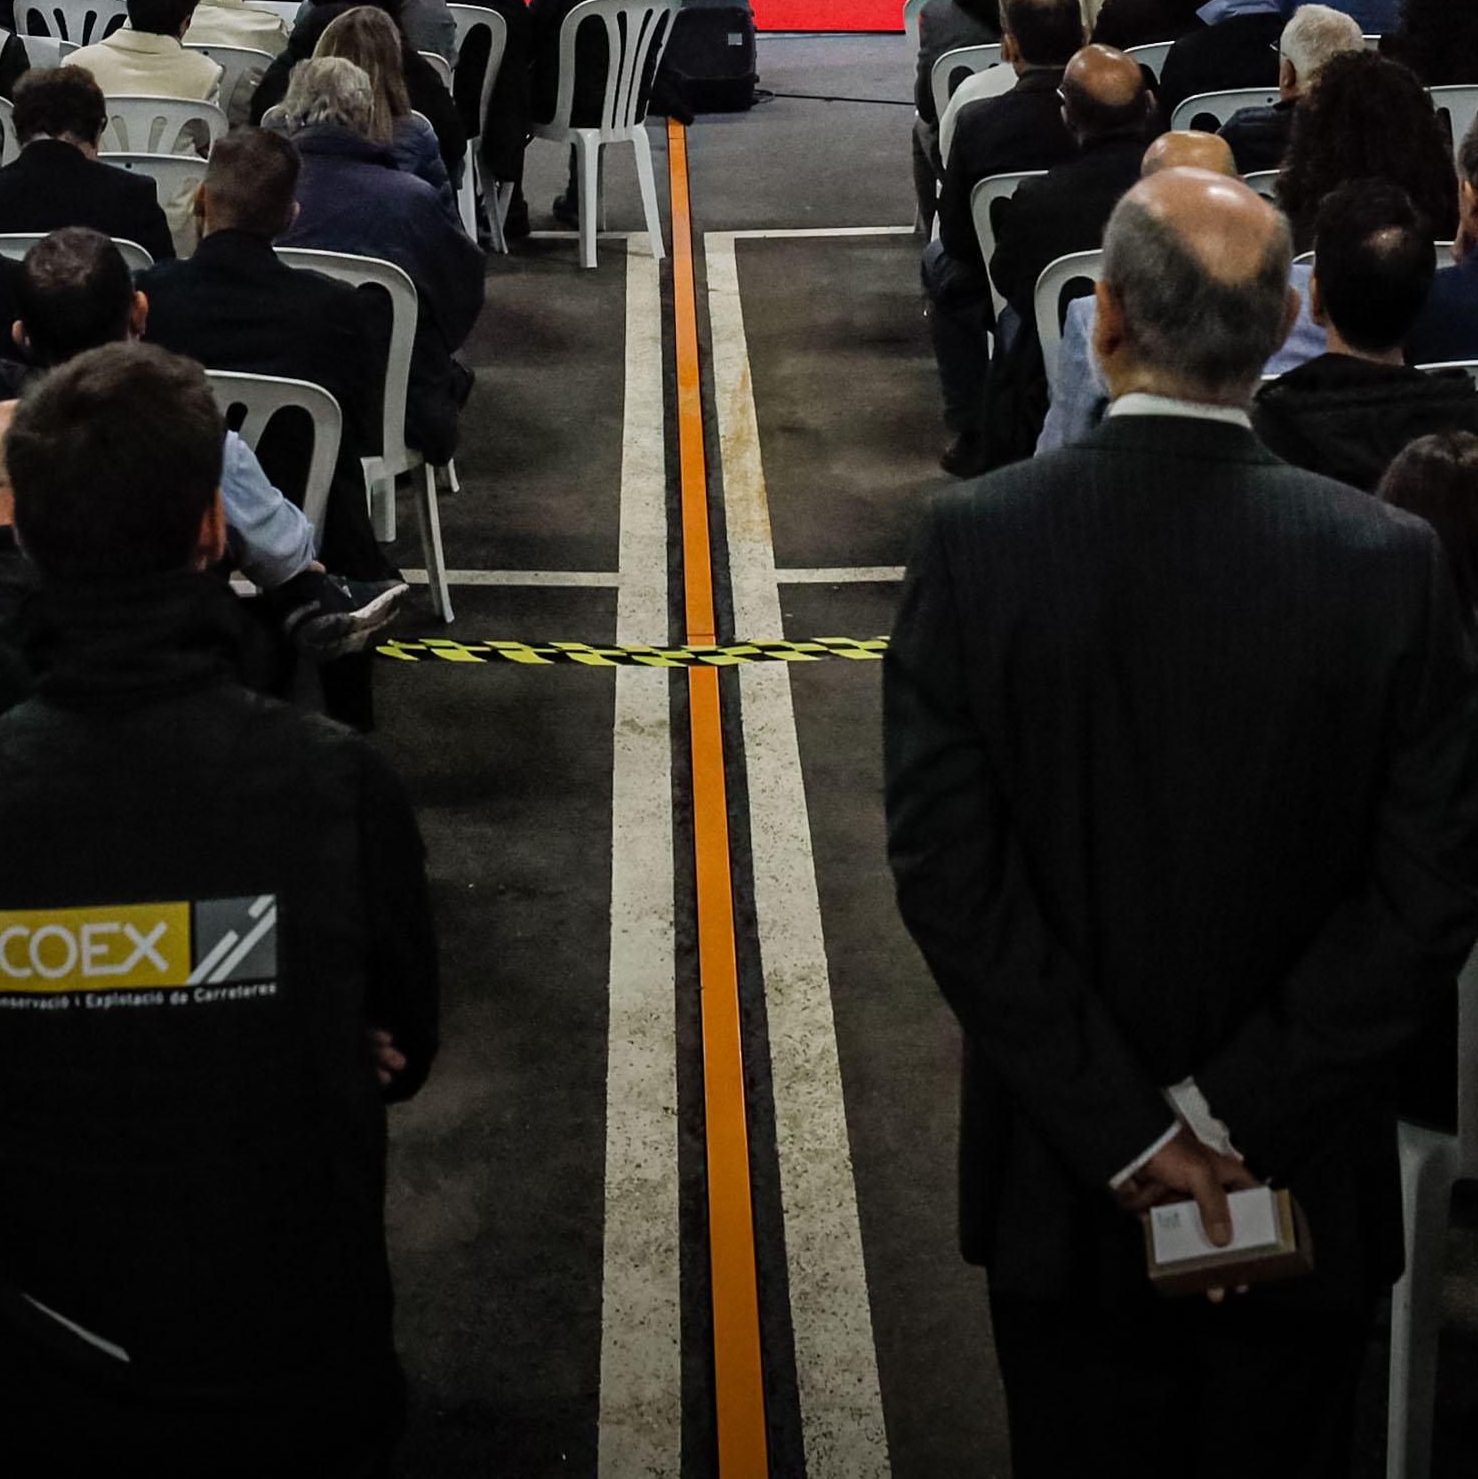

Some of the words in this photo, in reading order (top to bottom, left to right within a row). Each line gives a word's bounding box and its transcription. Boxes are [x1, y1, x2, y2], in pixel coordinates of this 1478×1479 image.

[85, 991, 164, 1009] Explotació
[170, 991, 189, 1005] de
[194, 983, 277, 1003] Carreteres
